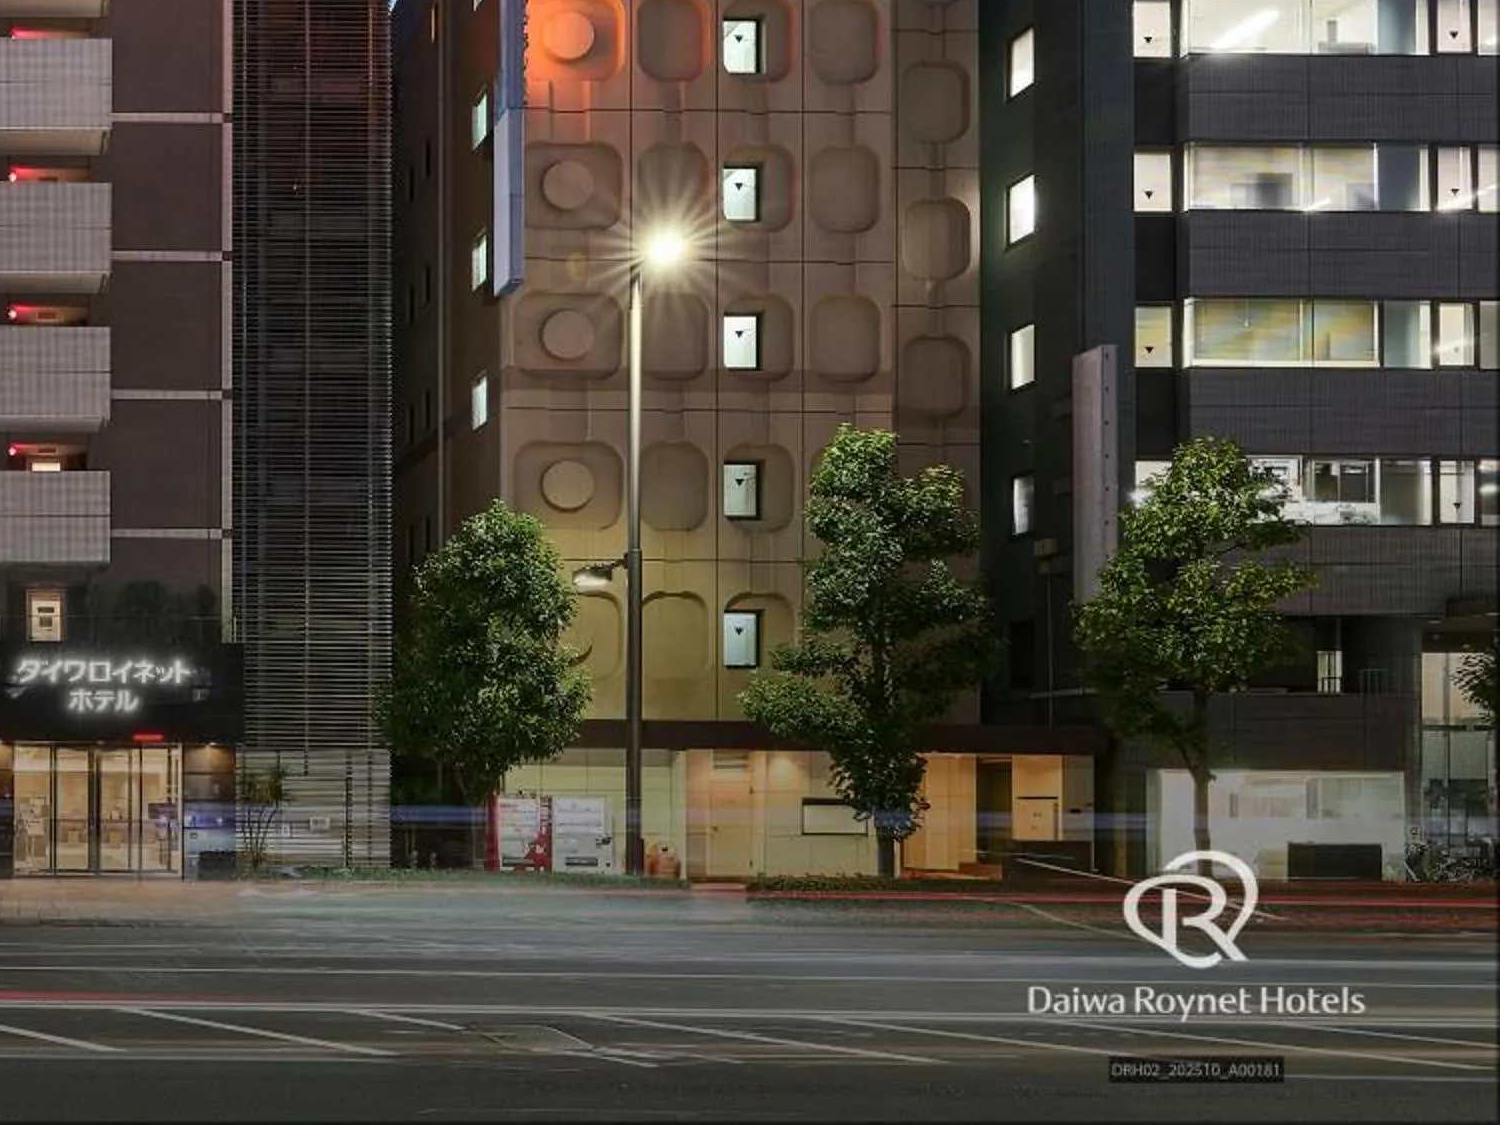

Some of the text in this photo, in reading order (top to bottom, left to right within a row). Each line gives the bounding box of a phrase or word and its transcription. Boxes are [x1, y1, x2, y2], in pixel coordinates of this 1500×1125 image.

[16, 659, 192, 684] ダイワロイネット
[67, 688, 140, 712] ホテル
